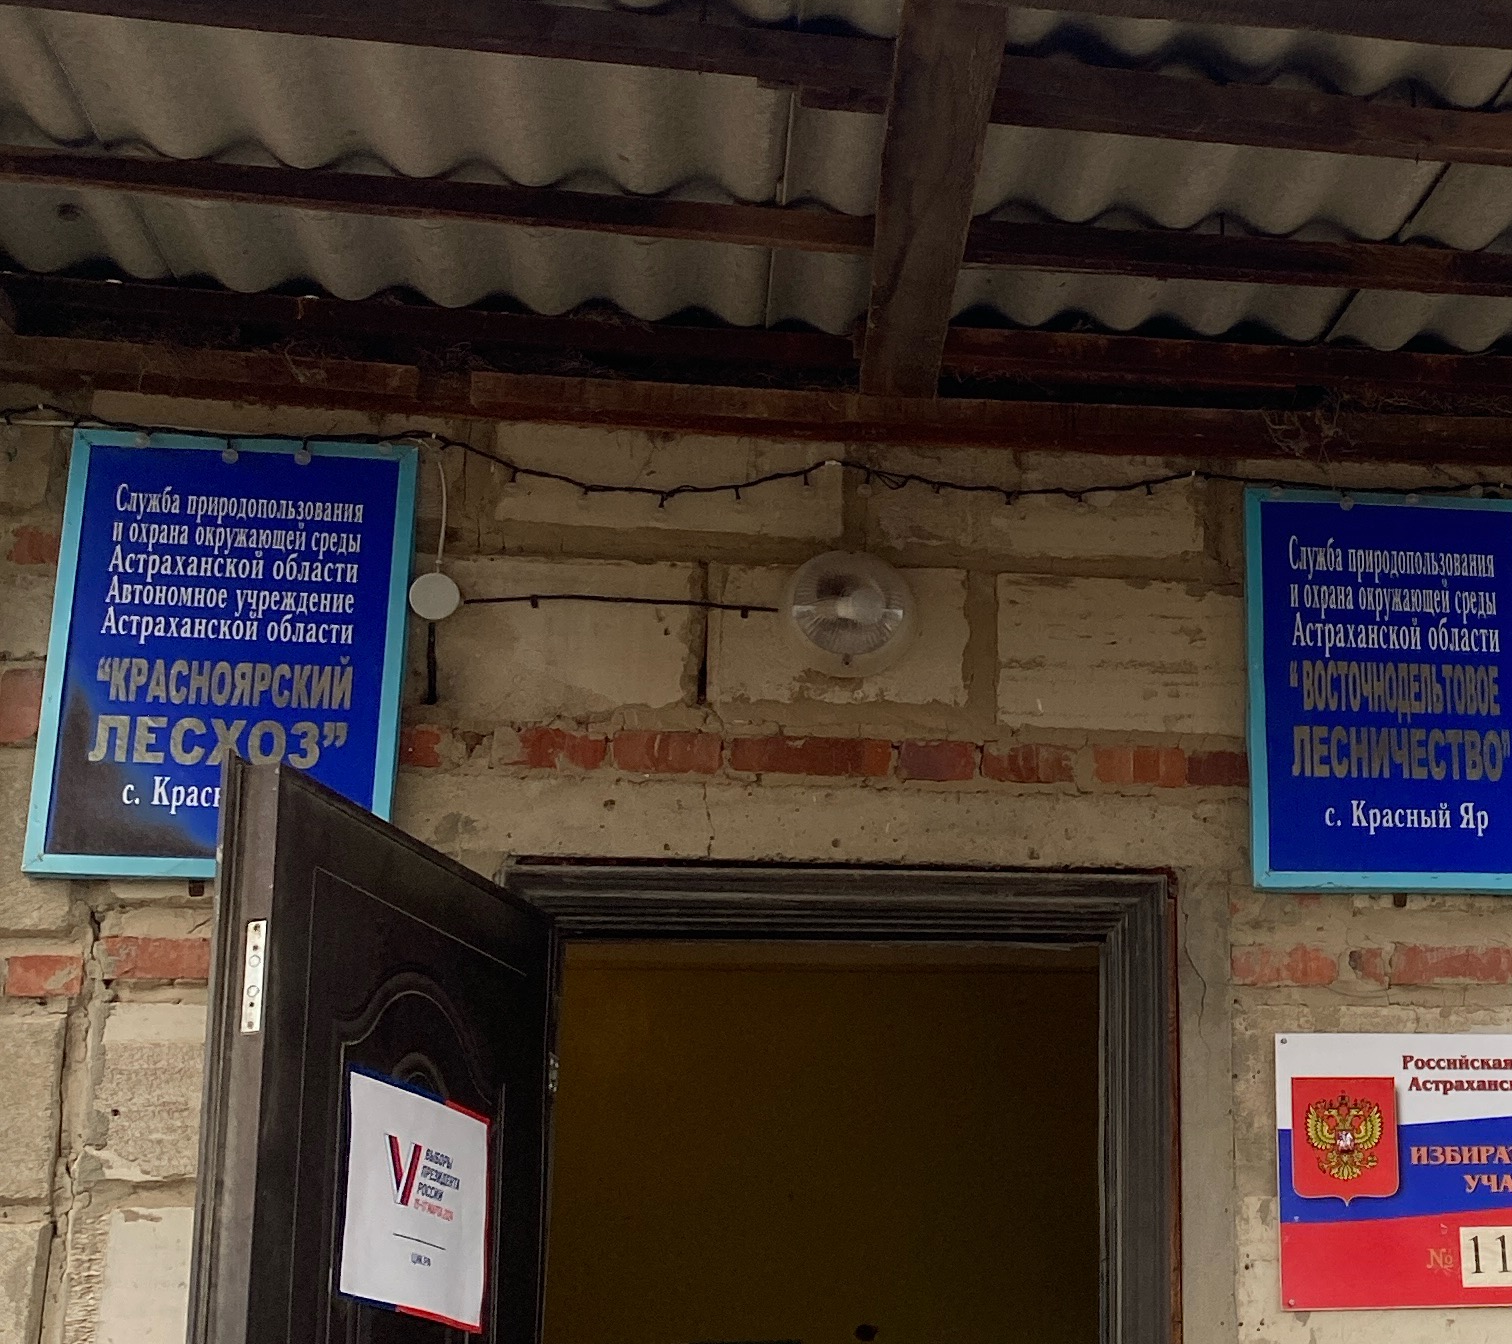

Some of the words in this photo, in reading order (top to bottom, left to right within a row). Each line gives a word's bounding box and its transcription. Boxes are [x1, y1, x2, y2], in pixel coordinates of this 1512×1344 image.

[116, 483, 180, 519] Служба
[187, 495, 363, 525] природопользования
[112, 520, 122, 541] и
[128, 523, 188, 546] охрана
[195, 523, 305, 554] окружающей
[311, 529, 361, 554] среды
[108, 545, 263, 582] Астраханской
[272, 553, 358, 583] области
[1289, 535, 1343, 579] Служба
[1348, 548, 1494, 581] природопользования
[105, 576, 227, 609] Автономное
[236, 587, 354, 617] учреждение
[1290, 584, 1298, 607] и
[1304, 584, 1353, 617] охрана
[1359, 579, 1450, 621] окружающей
[1455, 589, 1496, 624] среды
[100, 607, 258, 643] Астраханской
[266, 617, 353, 645] области
[1292, 614, 1421, 657] Астраханской
[1429, 618, 1500, 653] области
[122, 783, 139, 805] с.
[1325, 808, 1341, 827] с.
[1351, 800, 1451, 834] Красный
[1460, 803, 1489, 836] Яр
